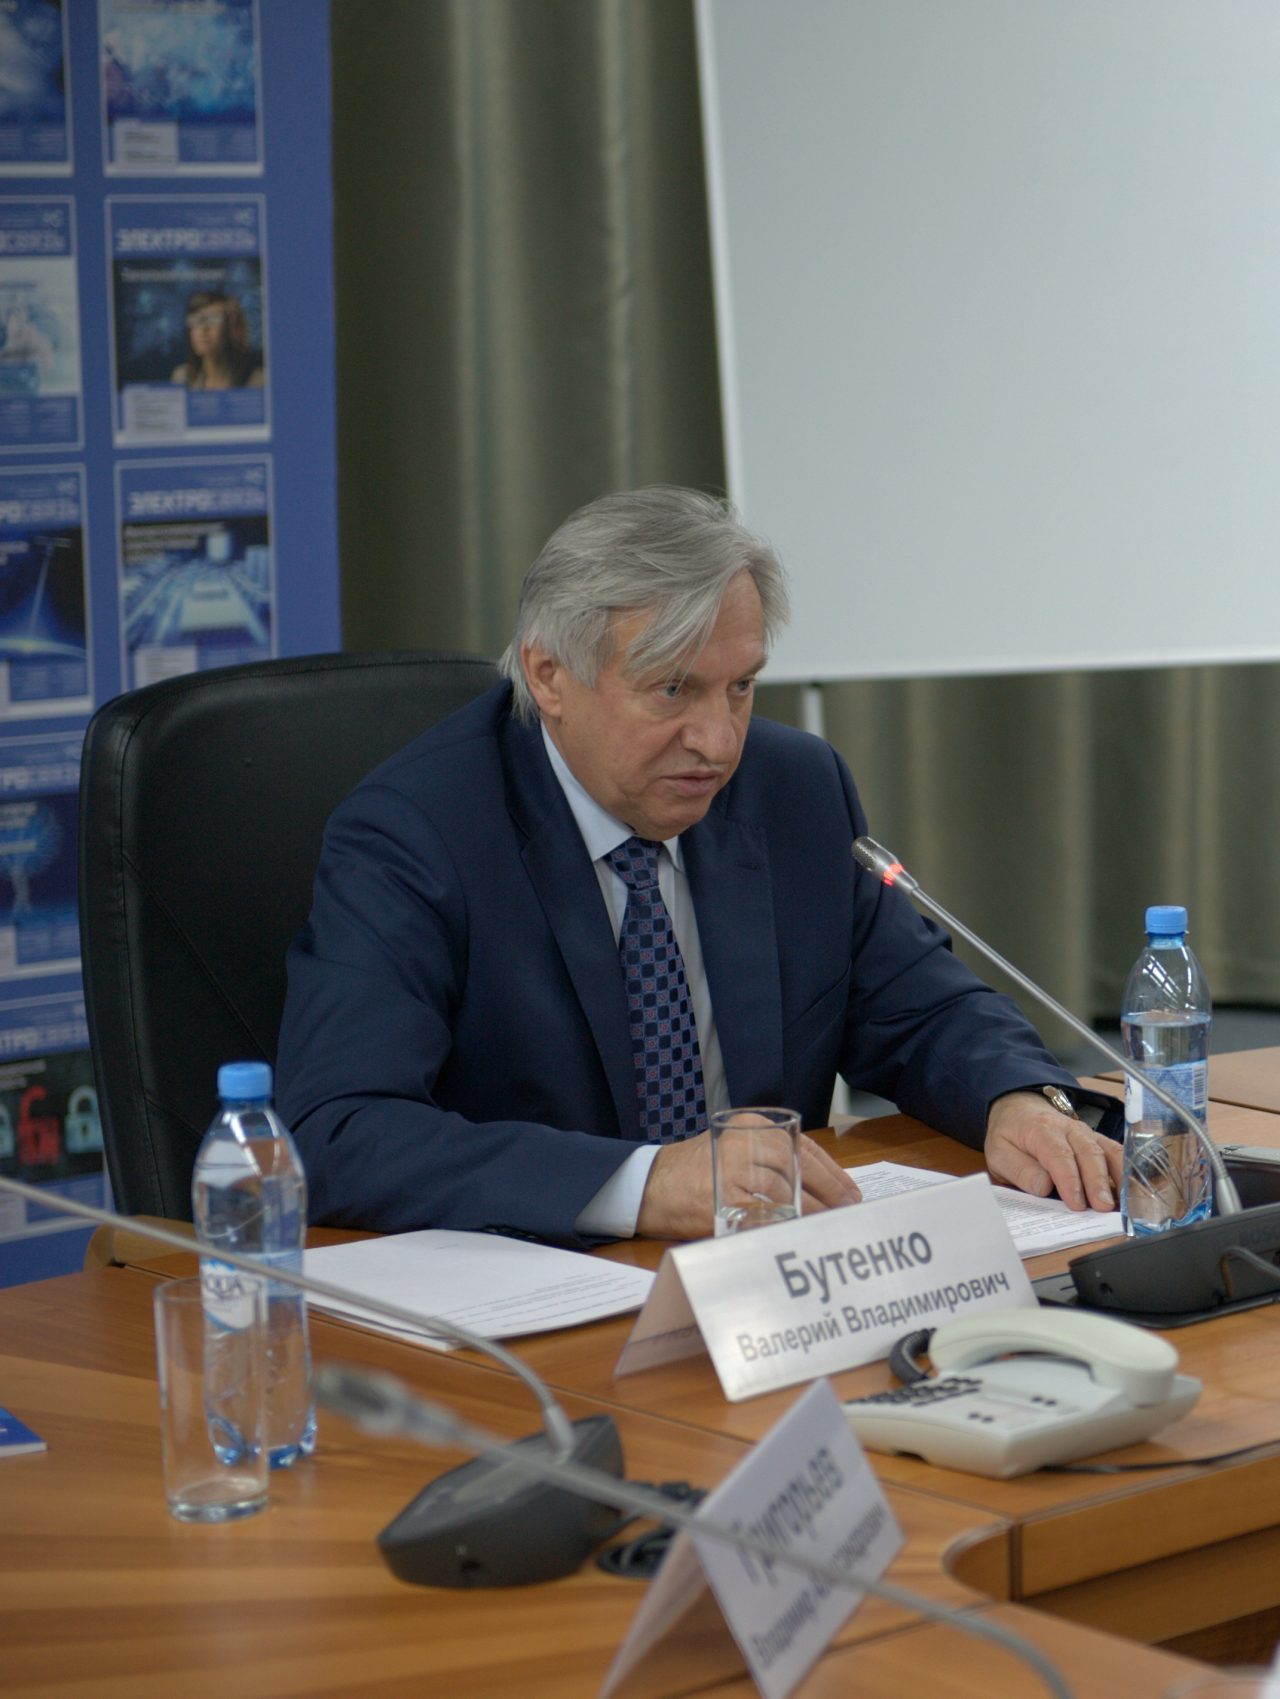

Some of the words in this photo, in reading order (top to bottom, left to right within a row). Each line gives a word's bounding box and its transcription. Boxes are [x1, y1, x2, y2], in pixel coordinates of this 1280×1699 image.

[774, 1231, 933, 1303] Бутенко
[737, 1311, 844, 1364] Валерий
[846, 1271, 1011, 1334] Владимирович
